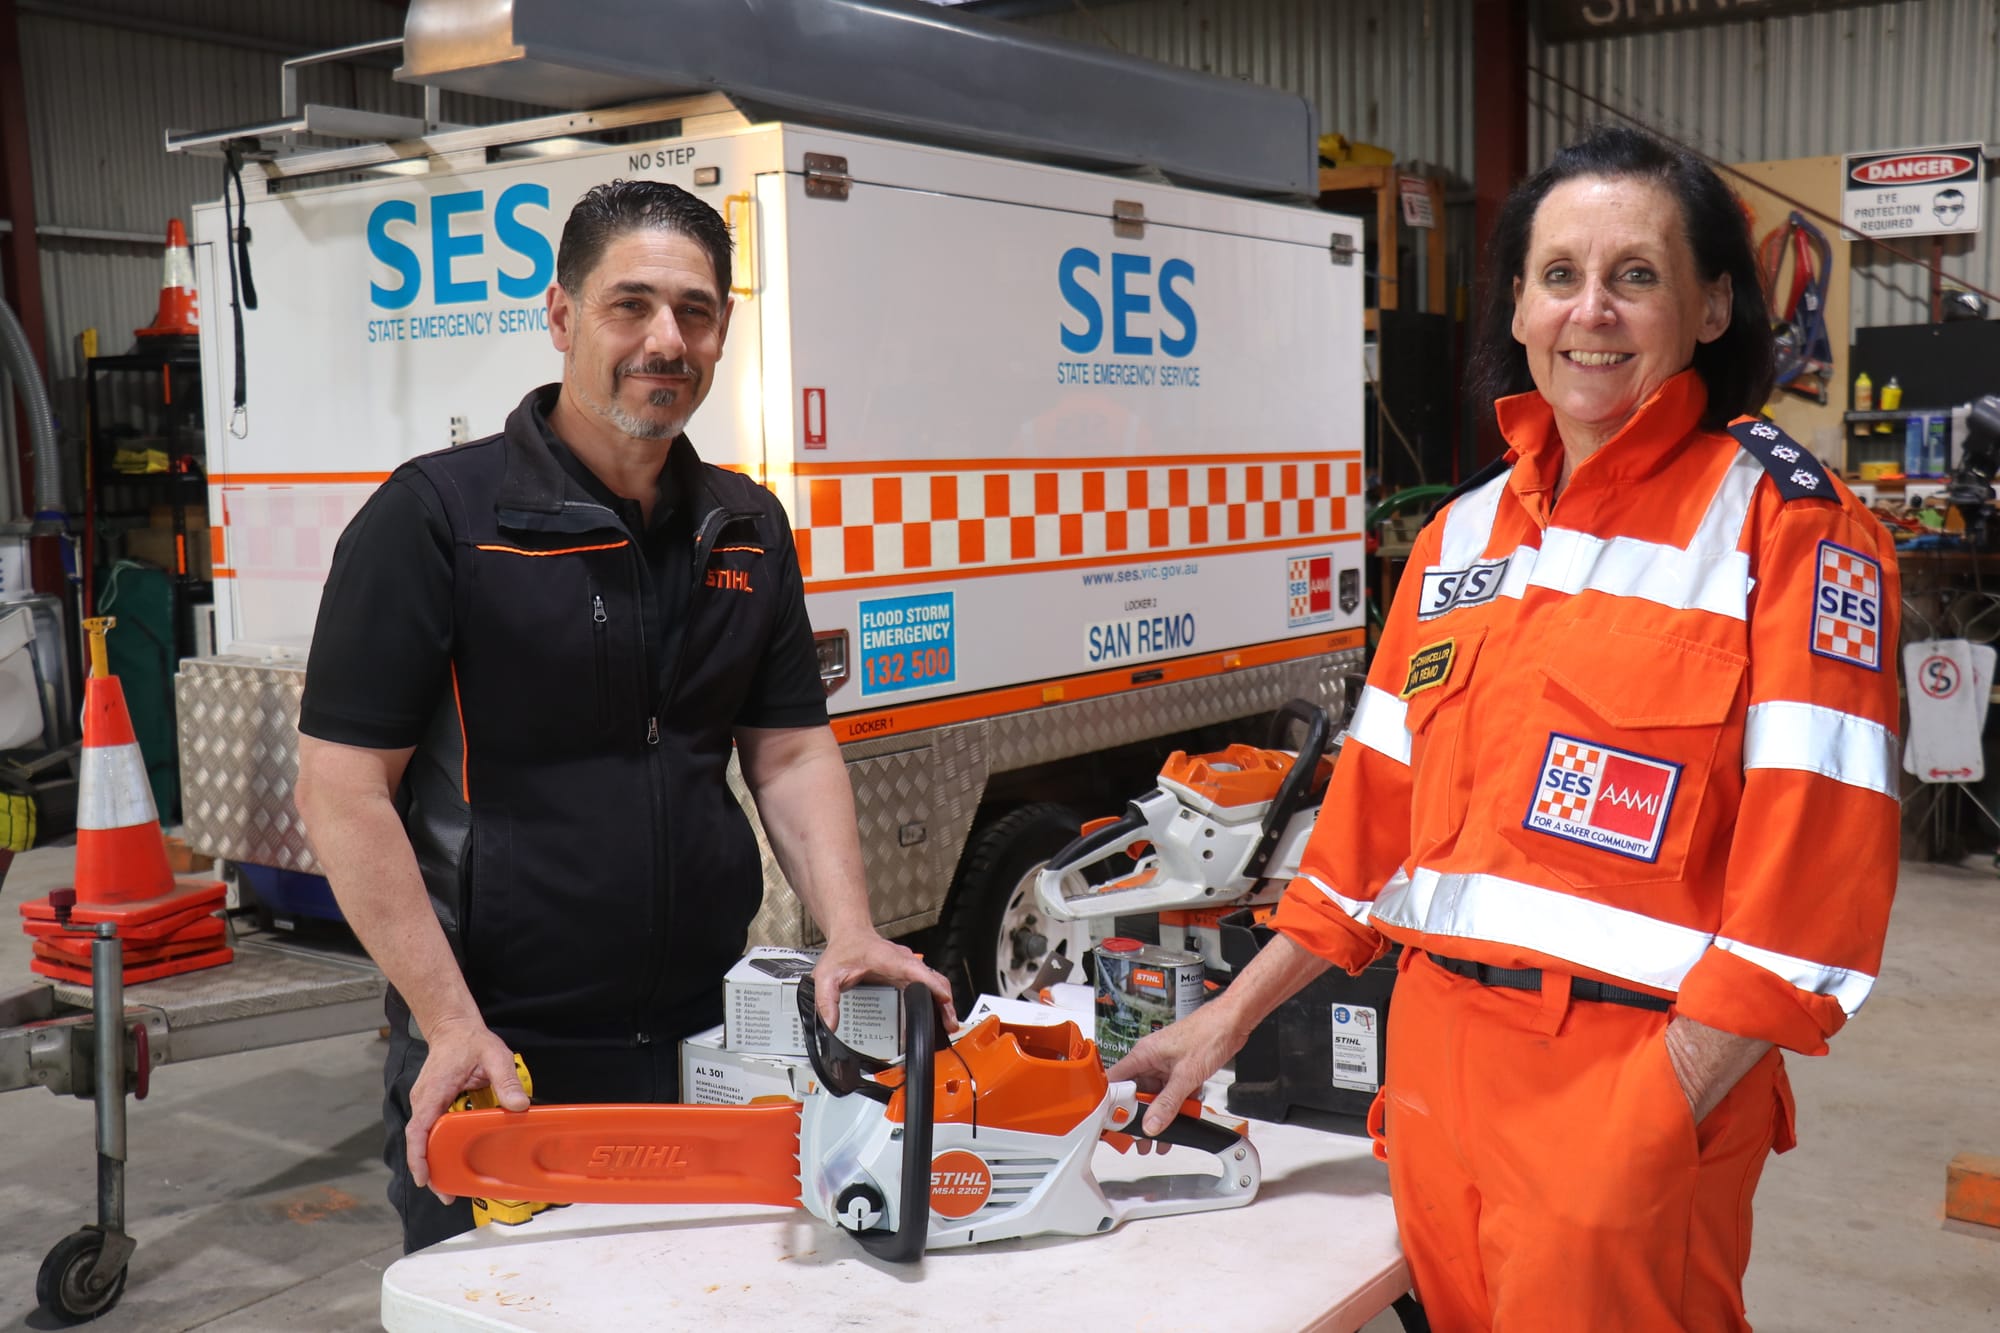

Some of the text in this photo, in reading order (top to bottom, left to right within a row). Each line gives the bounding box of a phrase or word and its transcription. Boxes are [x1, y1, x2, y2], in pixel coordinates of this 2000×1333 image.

[629, 147, 696, 172] NO STEP
[1868, 159, 1955, 180] DANGER
[1876, 193, 1898, 205] EYE
[1854, 204, 1921, 219] PROTECTION
[1861, 218, 1914, 232] REQUIRED
[367, 183, 555, 310] SES
[1058, 247, 1197, 358] SES
[368, 306, 549, 342] STATE EMERGENCY SERVIC
[1057, 362, 1200, 387] STATE EMERGENCY SERVICE
[705, 569, 753, 593] STIHL
[1083, 563, 1198, 587] www.ses.vic.gov.au
[1289, 581, 1307, 597] SES
[862, 604, 950, 629] FLOOD STORM
[1124, 598, 1157, 611] LOCKER 2
[1820, 586, 1876, 626] SES
[863, 621, 951, 650] EMERGENCY
[1089, 612, 1196, 662] SAN REMO
[865, 646, 950, 687] 132 500
[1420, 664, 1439, 682] REMO
[850, 717, 894, 737] LOCKER 1
[1545, 768, 1593, 797] SES
[1598, 783, 1660, 815] AAMI
[1533, 815, 1649, 854] FOR A SAFER COMMUNITY
[1136, 973, 1161, 983] STIHL
[1335, 1036, 1361, 1046] STIHL
[696, 1066, 724, 1079] AL 301
[723, 1091, 744, 1101] CHARGER
[588, 1145, 688, 1169] STIHL
[930, 1172, 987, 1186] STIHL
[932, 1187, 985, 1195] MSA 220C
